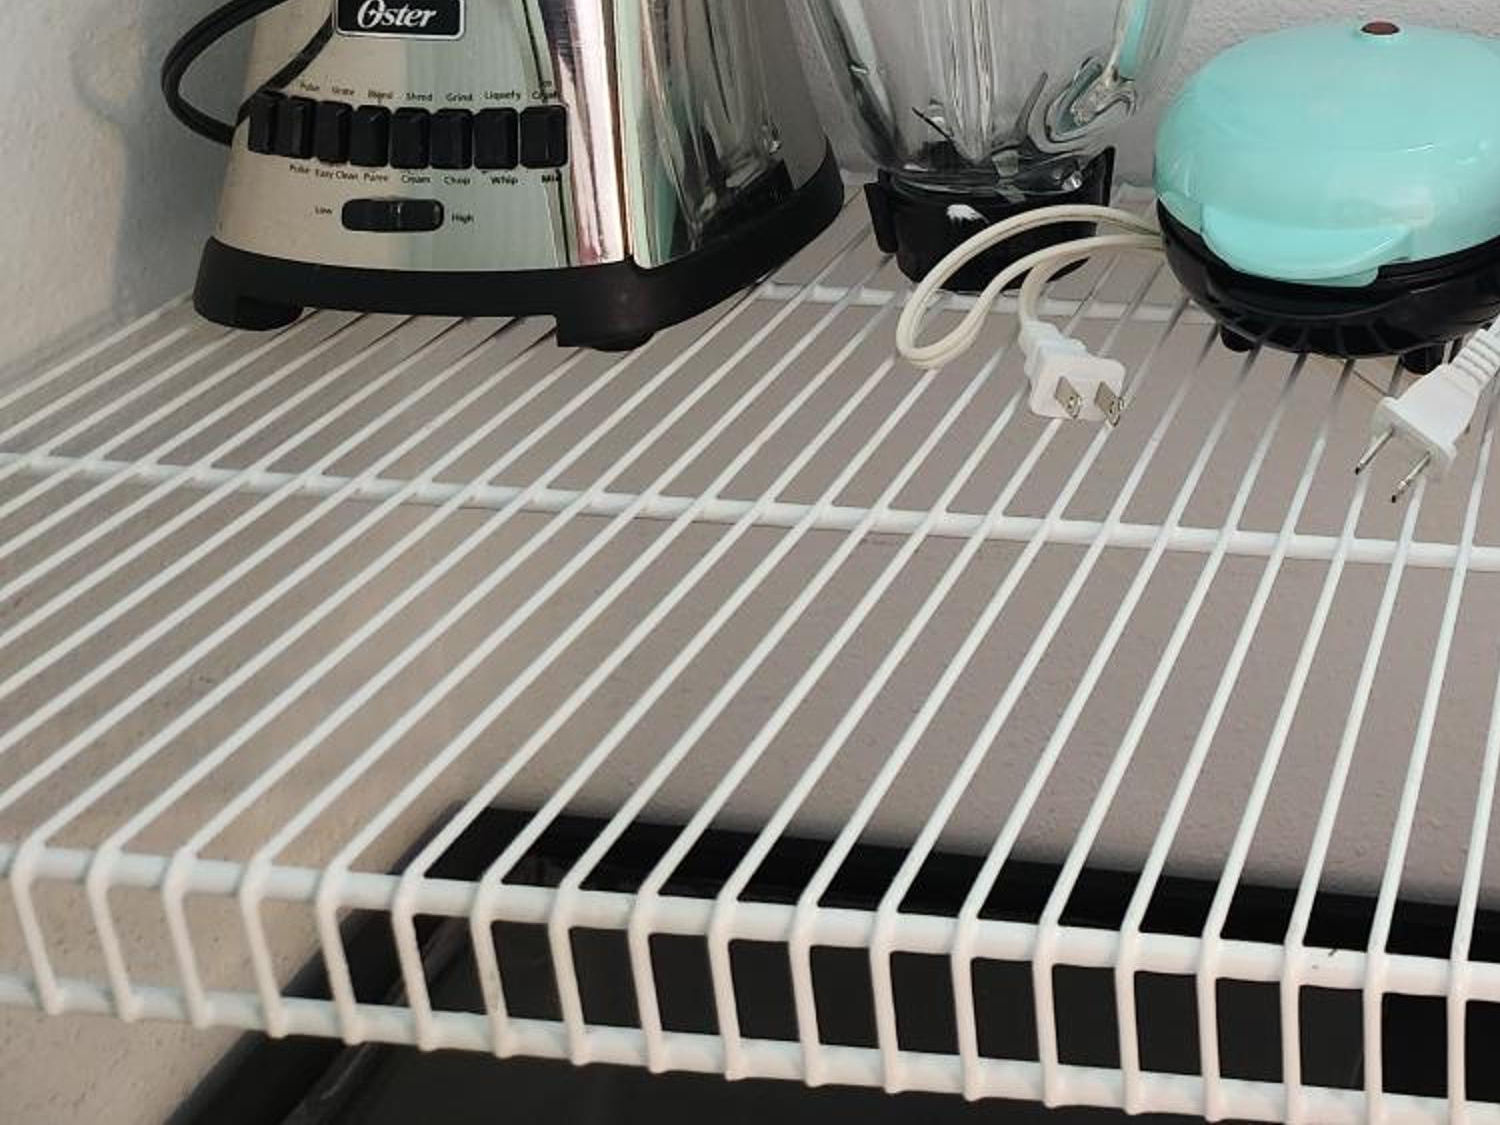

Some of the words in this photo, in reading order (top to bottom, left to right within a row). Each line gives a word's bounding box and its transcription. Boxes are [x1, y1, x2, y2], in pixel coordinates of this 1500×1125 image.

[446, 92, 473, 102] Grind
[490, 175, 519, 186] Whip
[451, 213, 475, 224] High
